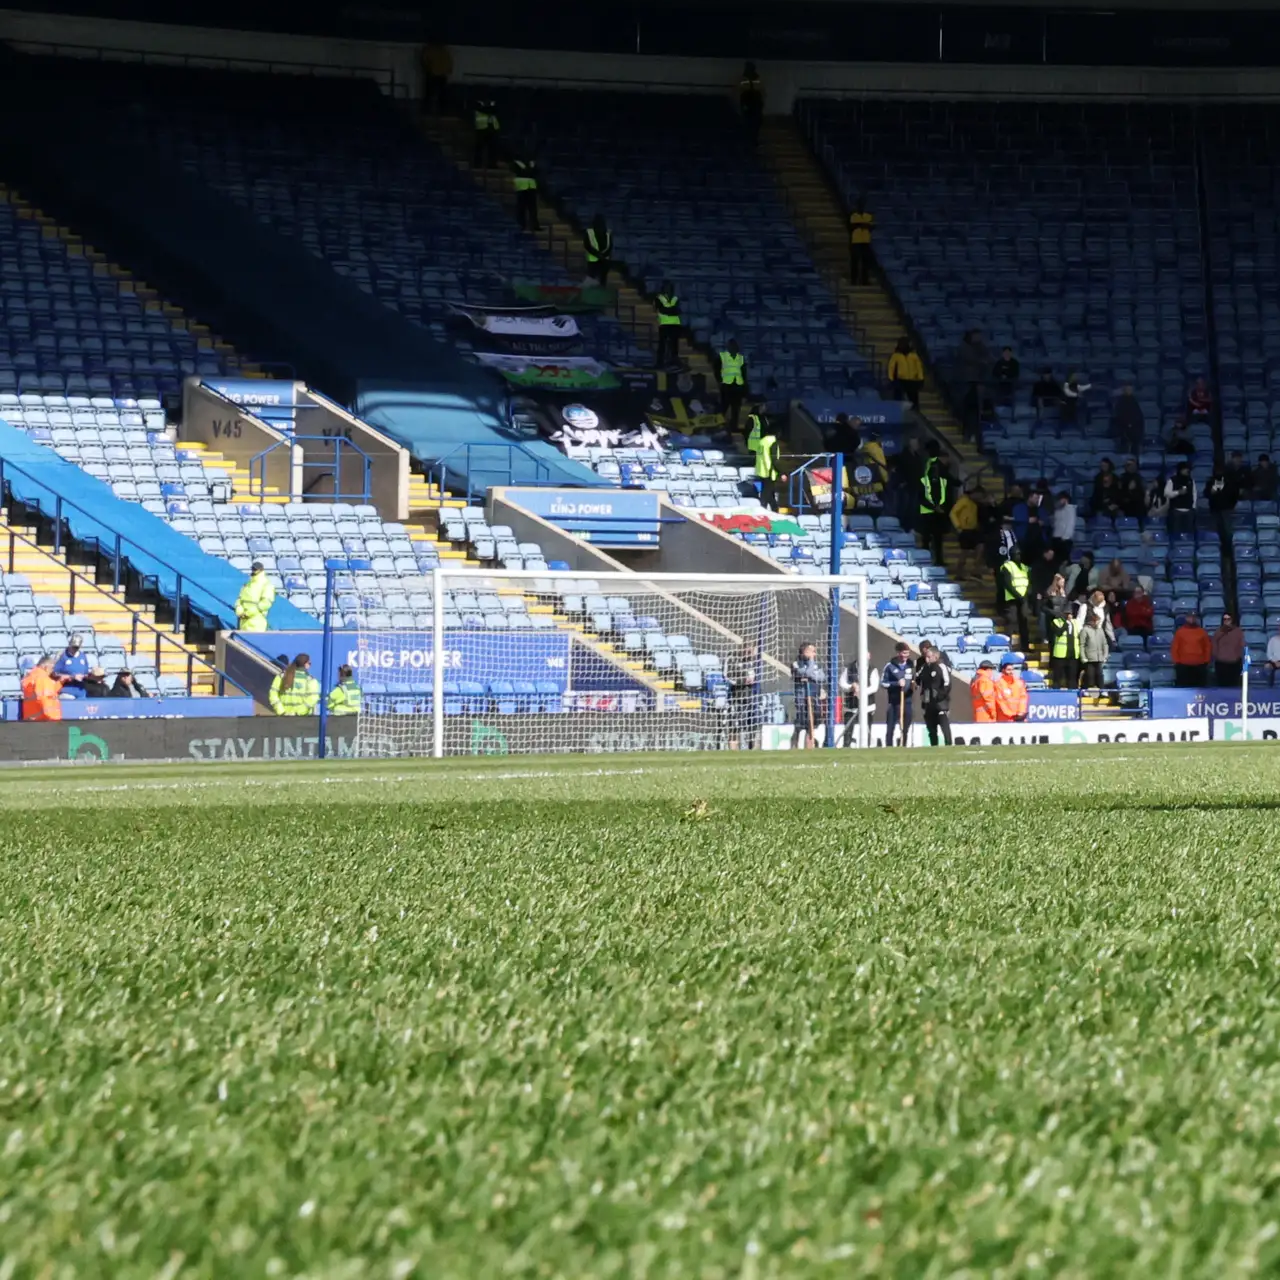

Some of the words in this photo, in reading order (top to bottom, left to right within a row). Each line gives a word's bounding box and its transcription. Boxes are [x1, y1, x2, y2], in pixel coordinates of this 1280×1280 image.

[243, 394, 279, 404] POWER
[212, 420, 242, 438] V45
[578, 503, 612, 515] POWER
[348, 651, 394, 668] KING
[400, 651, 462, 668] POWER
[1028, 704, 1076, 719] POWER
[1186, 703, 1229, 716] KING
[189, 737, 256, 761] STAY
